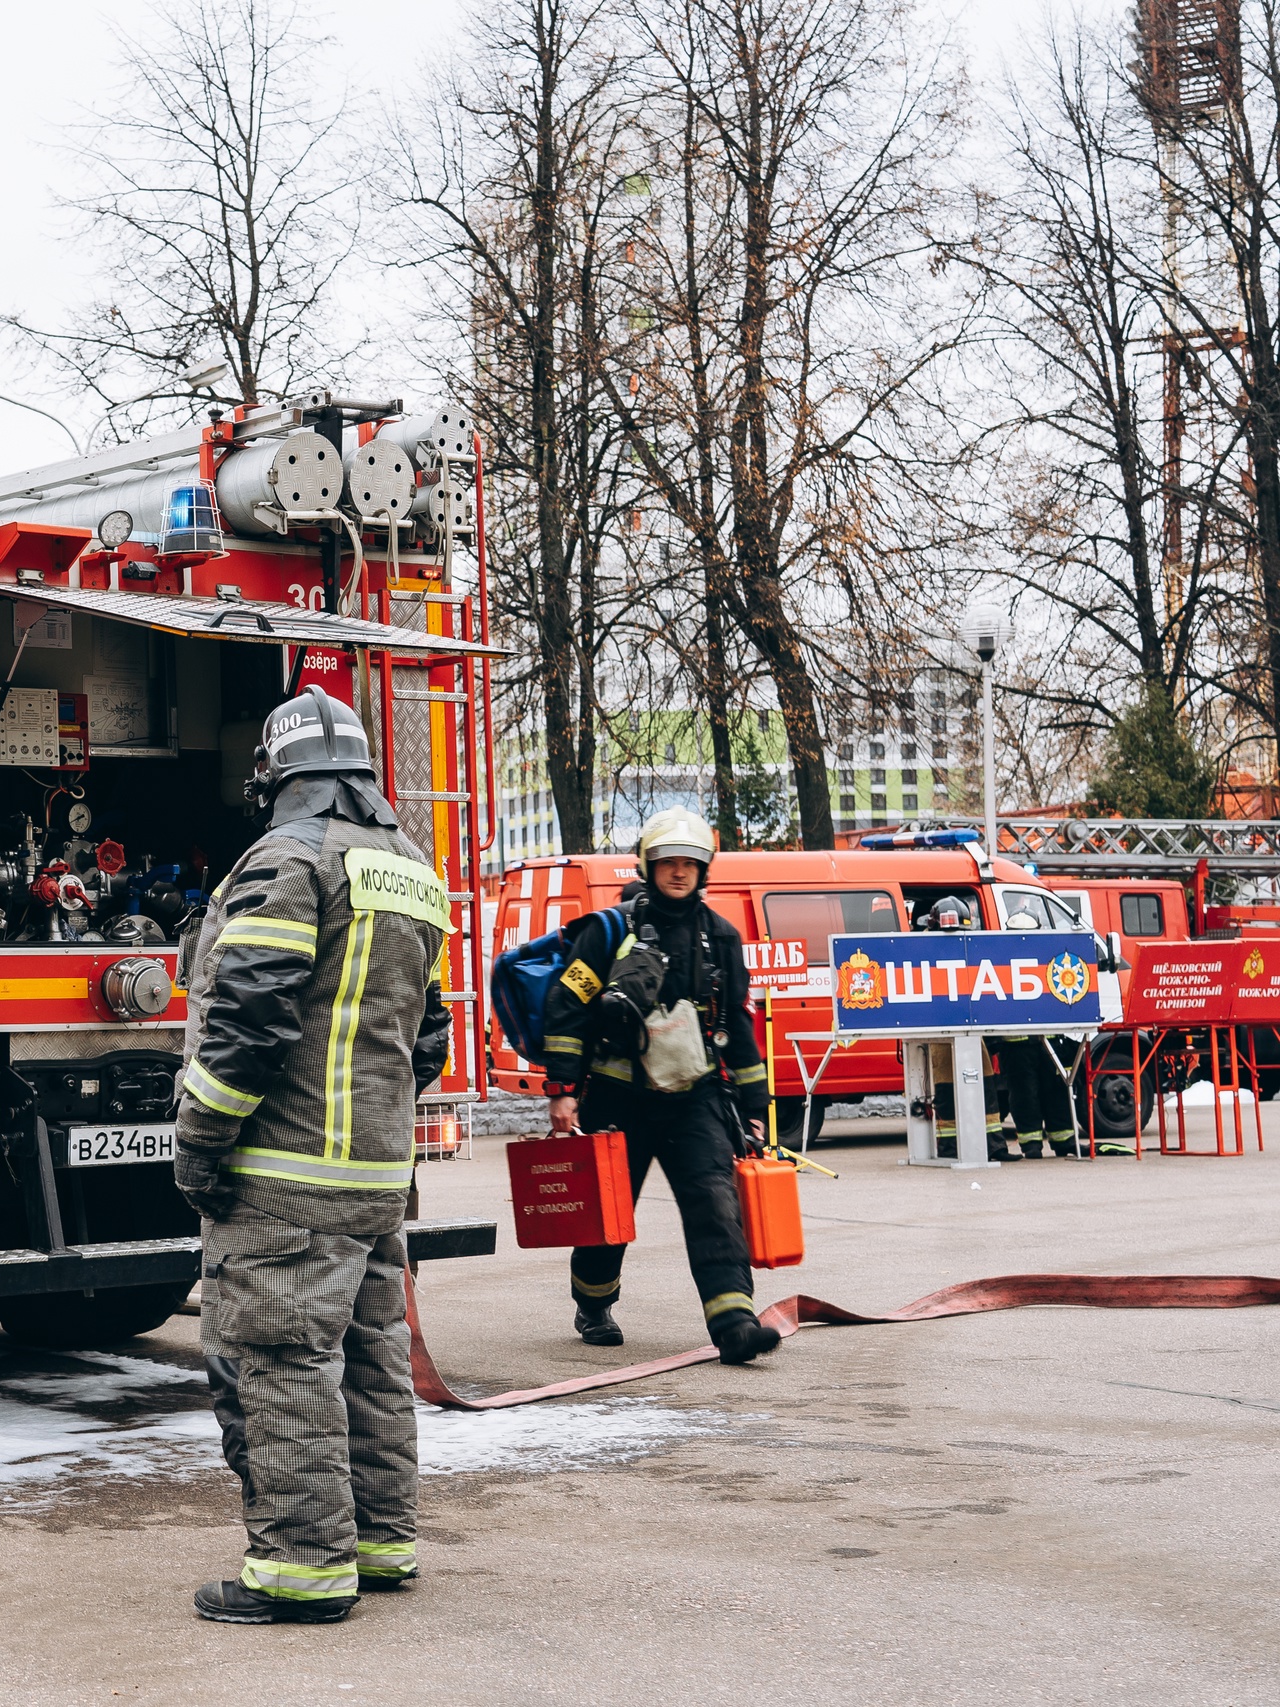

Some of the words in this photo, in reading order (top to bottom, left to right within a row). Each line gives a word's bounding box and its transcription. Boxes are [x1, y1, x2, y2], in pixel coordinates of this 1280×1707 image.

[303, 652, 338, 674] озёра
[1152, 961, 1222, 975] ЩЁЛКОВСКИЙ
[885, 958, 1044, 1004] ШТАБ
[1158, 975, 1211, 986] ПОЖАРНО-
[1143, 985, 1222, 998] СПАСАТЕЛЬНЫЙ
[1155, 999, 1206, 1010] ГАРНИЗОН
[79, 1130, 172, 1161] В234ВН
[530, 1162, 574, 1175] ПЛАНШЕТ
[538, 1183, 569, 1194] ПОСТА
